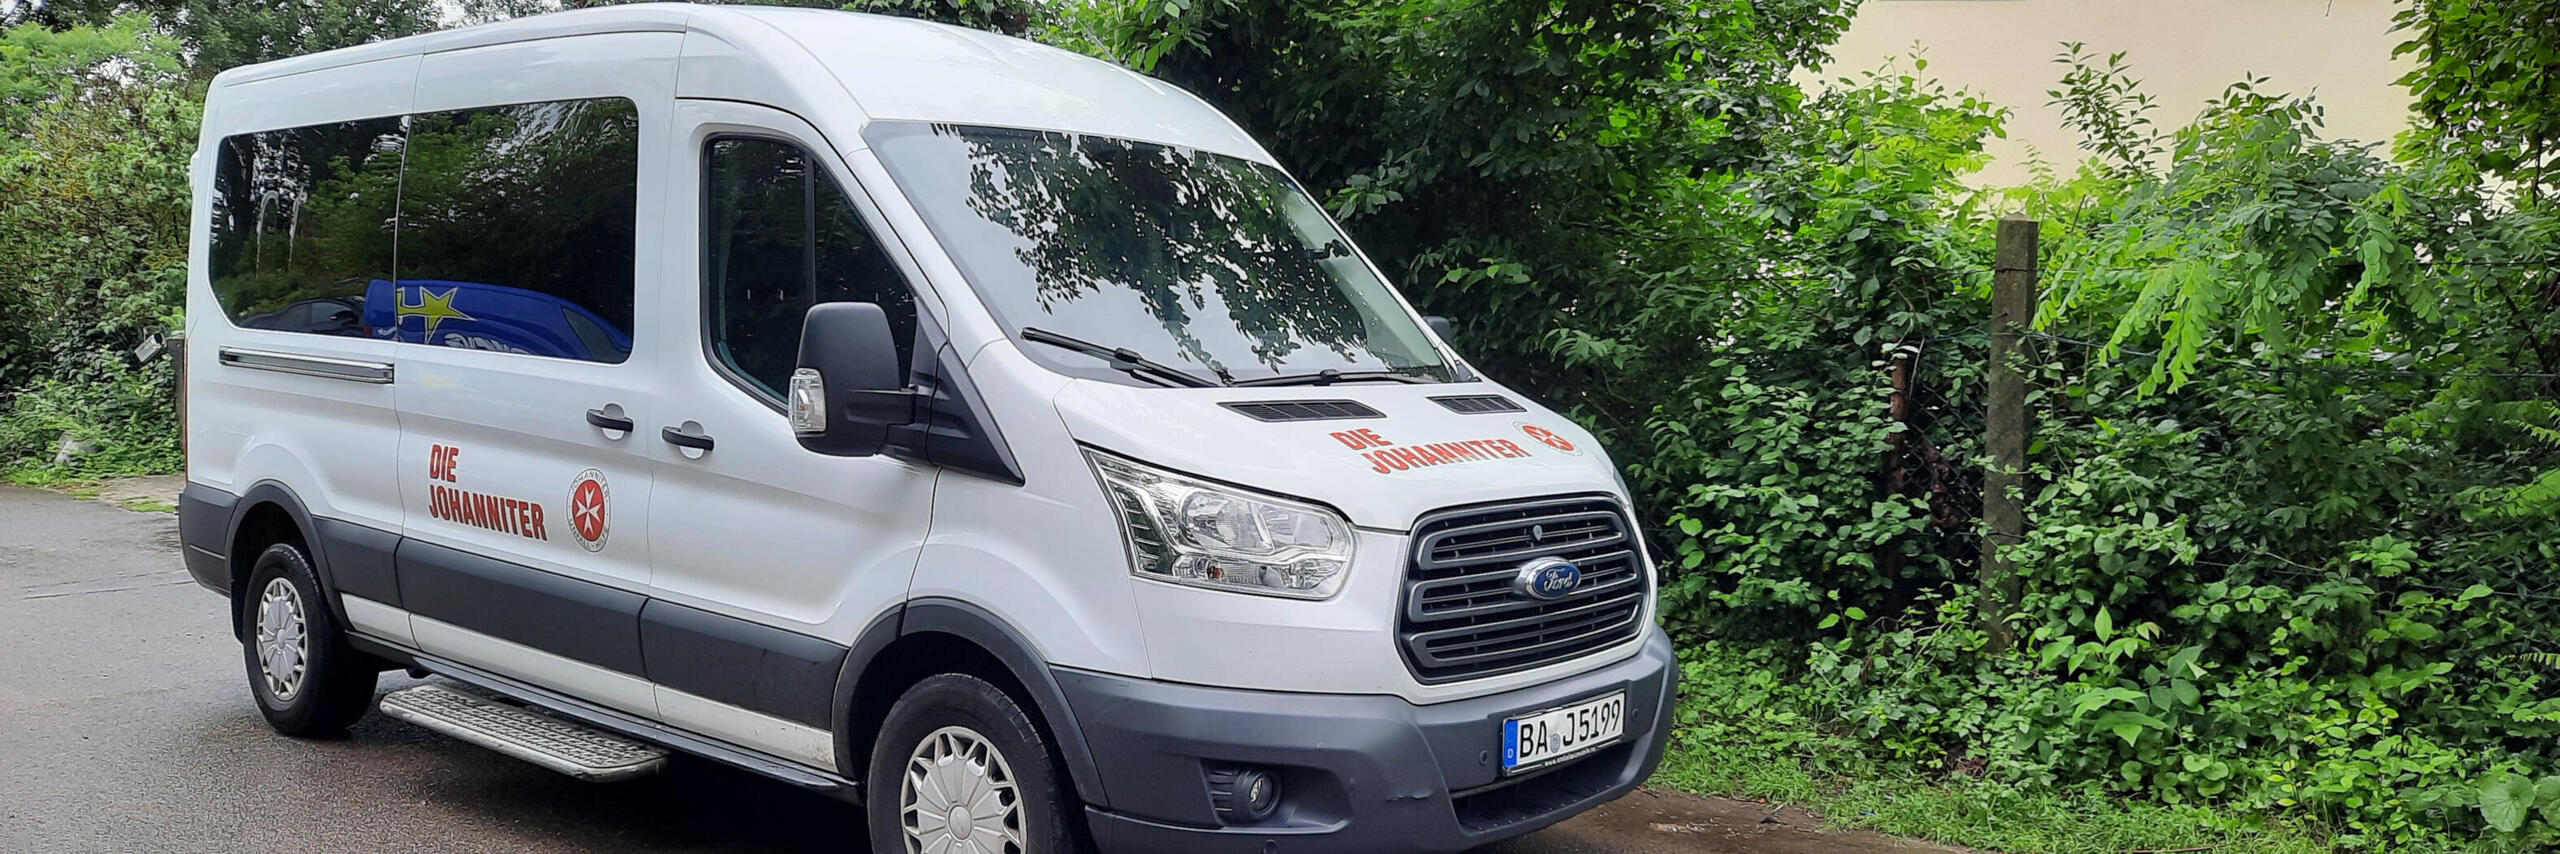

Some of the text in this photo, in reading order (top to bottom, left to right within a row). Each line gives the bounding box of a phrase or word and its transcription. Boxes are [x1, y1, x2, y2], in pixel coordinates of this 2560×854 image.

[1329, 428, 1393, 451] DIE
[1361, 438, 1532, 474] JOHANNITER
[429, 444, 459, 483] DIE
[429, 484, 548, 541] JOHANNITER
[1543, 567, 1573, 592] Ford
[1519, 719, 1548, 759] BA
